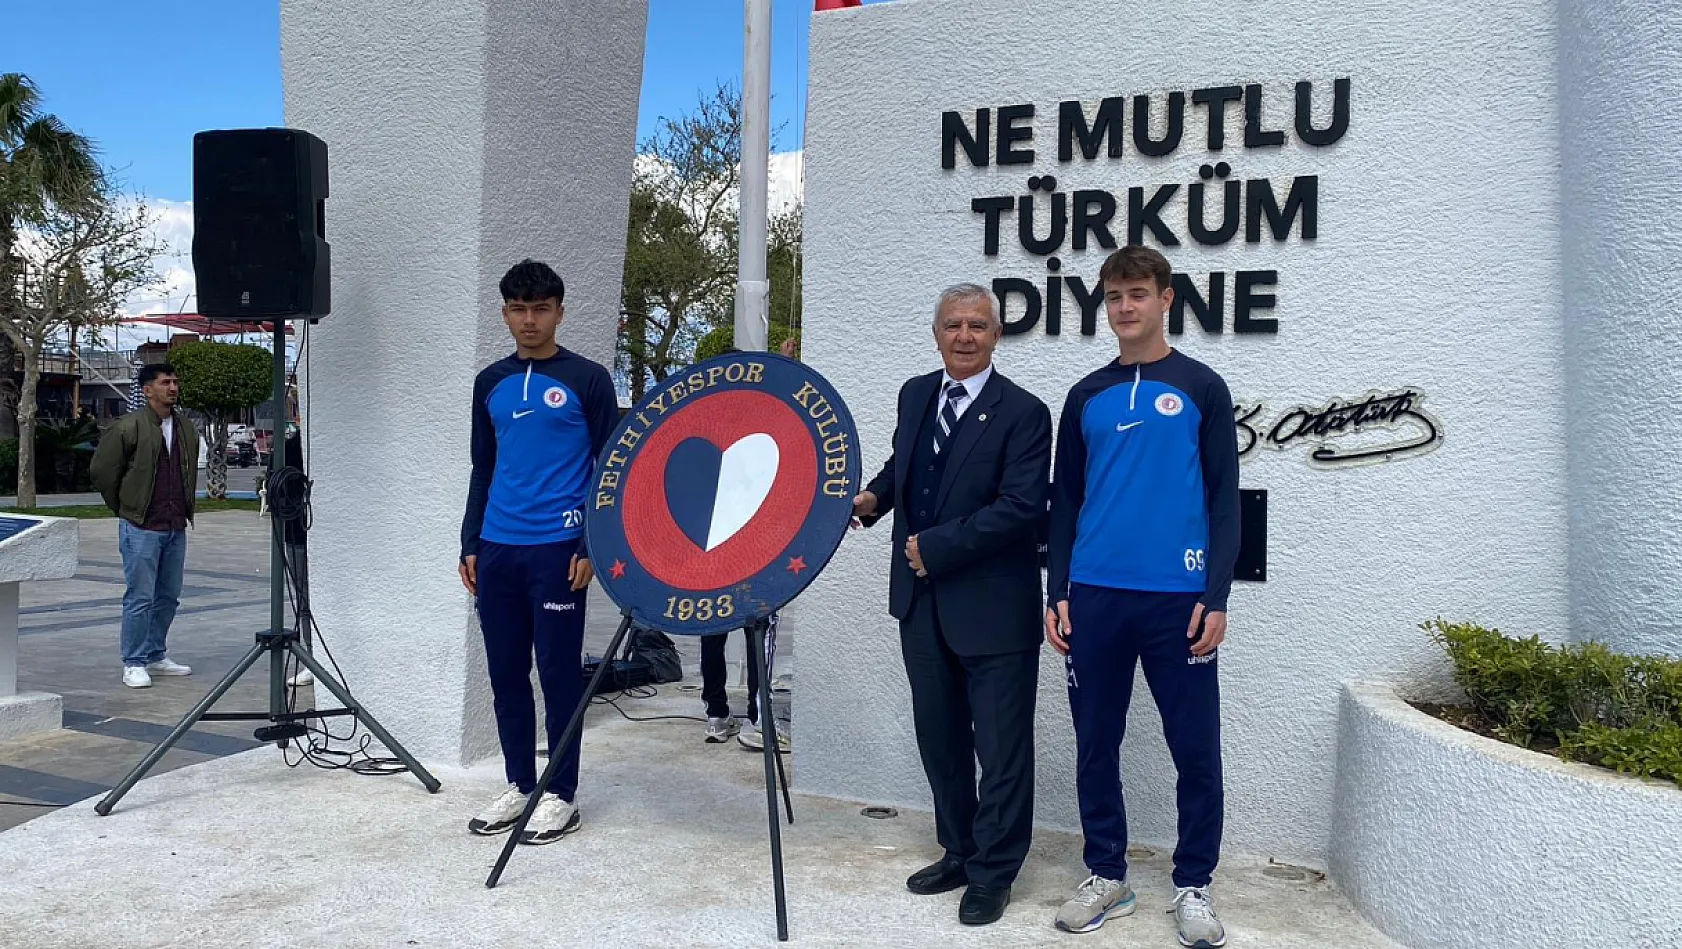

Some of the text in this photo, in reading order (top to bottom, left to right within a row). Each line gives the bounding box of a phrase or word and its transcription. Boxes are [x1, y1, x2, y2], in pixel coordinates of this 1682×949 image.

[941, 78, 1351, 169] NE MUTLU
[971, 162, 1318, 255] TÜRKÜM
[992, 257, 1279, 336] DİYNE
[595, 361, 851, 510] FETHİYESPOR KULÜBÜ
[562, 509, 582, 528] 20
[663, 594, 735, 621] 1933
